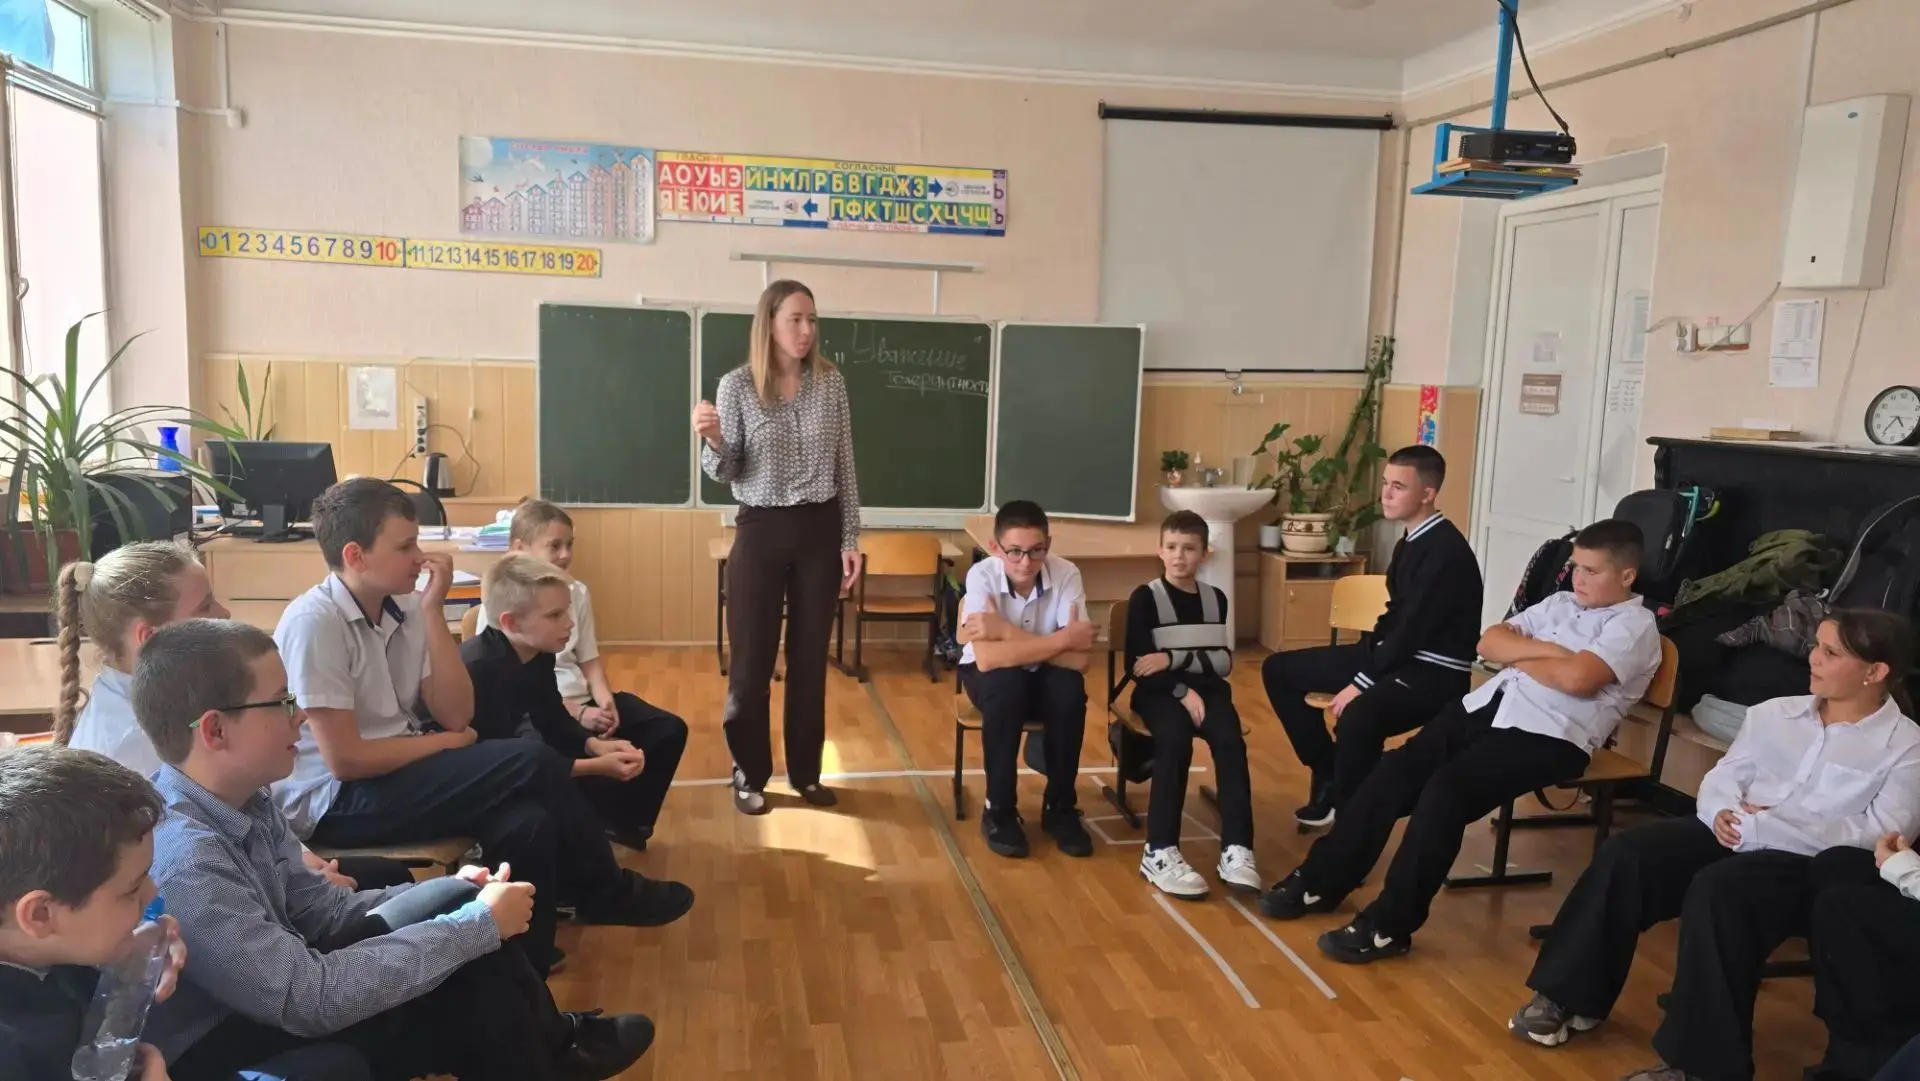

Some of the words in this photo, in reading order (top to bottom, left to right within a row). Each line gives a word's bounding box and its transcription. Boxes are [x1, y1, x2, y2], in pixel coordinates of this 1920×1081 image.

[834, 161, 897, 173] СОГЛАСНЫЕ
[206, 232, 217, 249] 0
[221, 232, 230, 251] 1
[237, 233, 250, 252] 2
[255, 233, 267, 253] 3
[272, 234, 285, 254] 4
[290, 235, 302, 255] 5
[307, 236, 320, 256] 6
[324, 238, 337, 257] 7
[342, 239, 355, 258] 8
[360, 240, 373, 259] 9
[376, 241, 397, 261] 10
[412, 245, 425, 262] 11
[429, 246, 443, 263] 12
[447, 246, 462, 264] 13
[465, 247, 480, 265] 14
[484, 248, 500, 266] 15
[503, 249, 519, 267] 16
[521, 251, 537, 268] 17
[539, 251, 556, 269] 18
[558, 252, 574, 270] 19
[576, 253, 594, 271] 20
